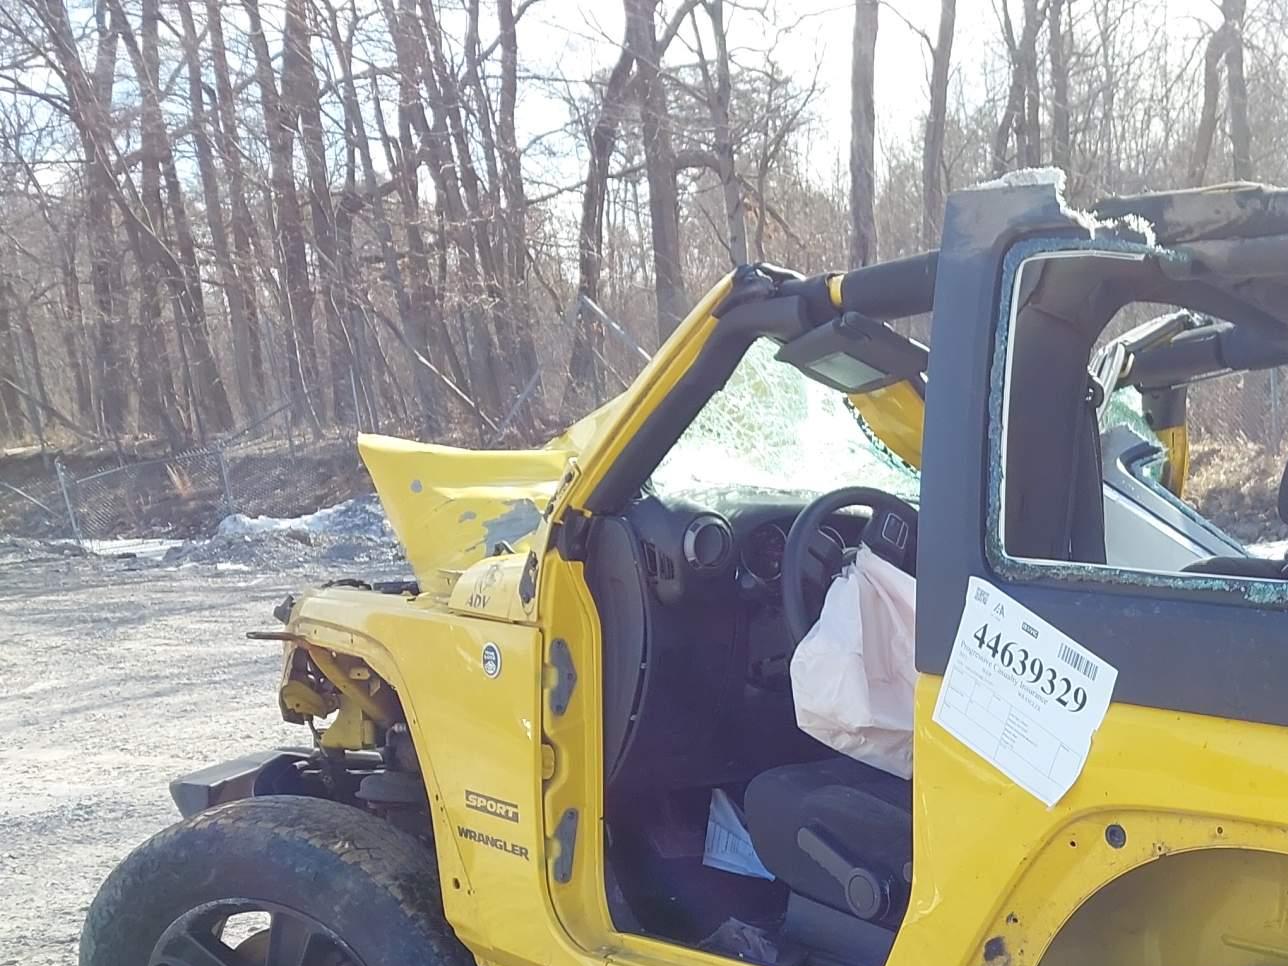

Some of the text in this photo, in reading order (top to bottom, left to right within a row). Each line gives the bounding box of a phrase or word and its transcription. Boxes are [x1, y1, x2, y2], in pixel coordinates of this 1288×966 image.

[973, 623, 1088, 713] 44639329
[467, 794, 519, 818] SPORT
[457, 825, 529, 861] WRANGLER
